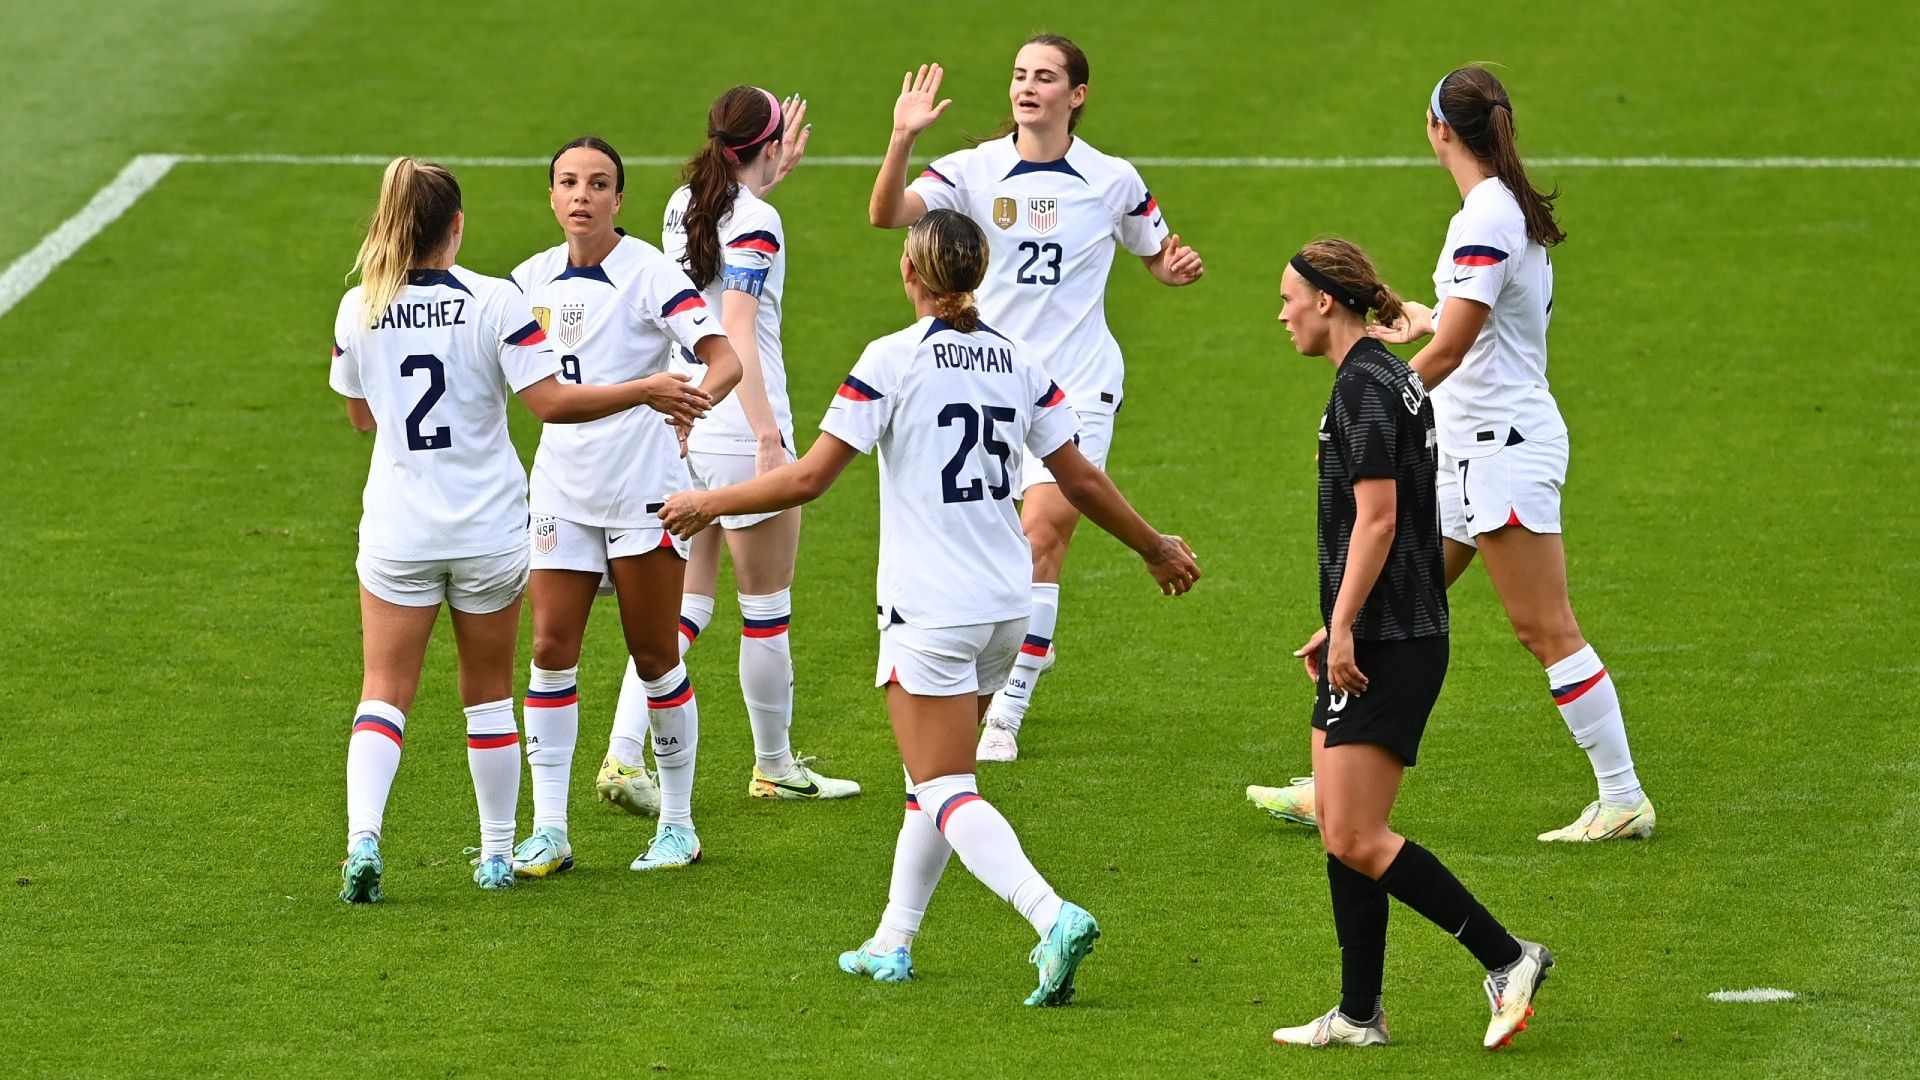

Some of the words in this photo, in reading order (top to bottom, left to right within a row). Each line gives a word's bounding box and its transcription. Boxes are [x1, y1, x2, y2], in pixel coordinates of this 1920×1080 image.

[1031, 200, 1054, 214] USA
[1017, 241, 1063, 286] 23
[563, 311, 582, 325] USA
[933, 343, 1013, 373] RODMAN
[561, 355, 582, 384] 9
[400, 354, 452, 451] 2
[937, 403, 1016, 503] 25
[537, 524, 554, 536] USA
[1009, 678, 1026, 690] USA
[526, 736, 539, 744] SA
[655, 736, 678, 745] USA
